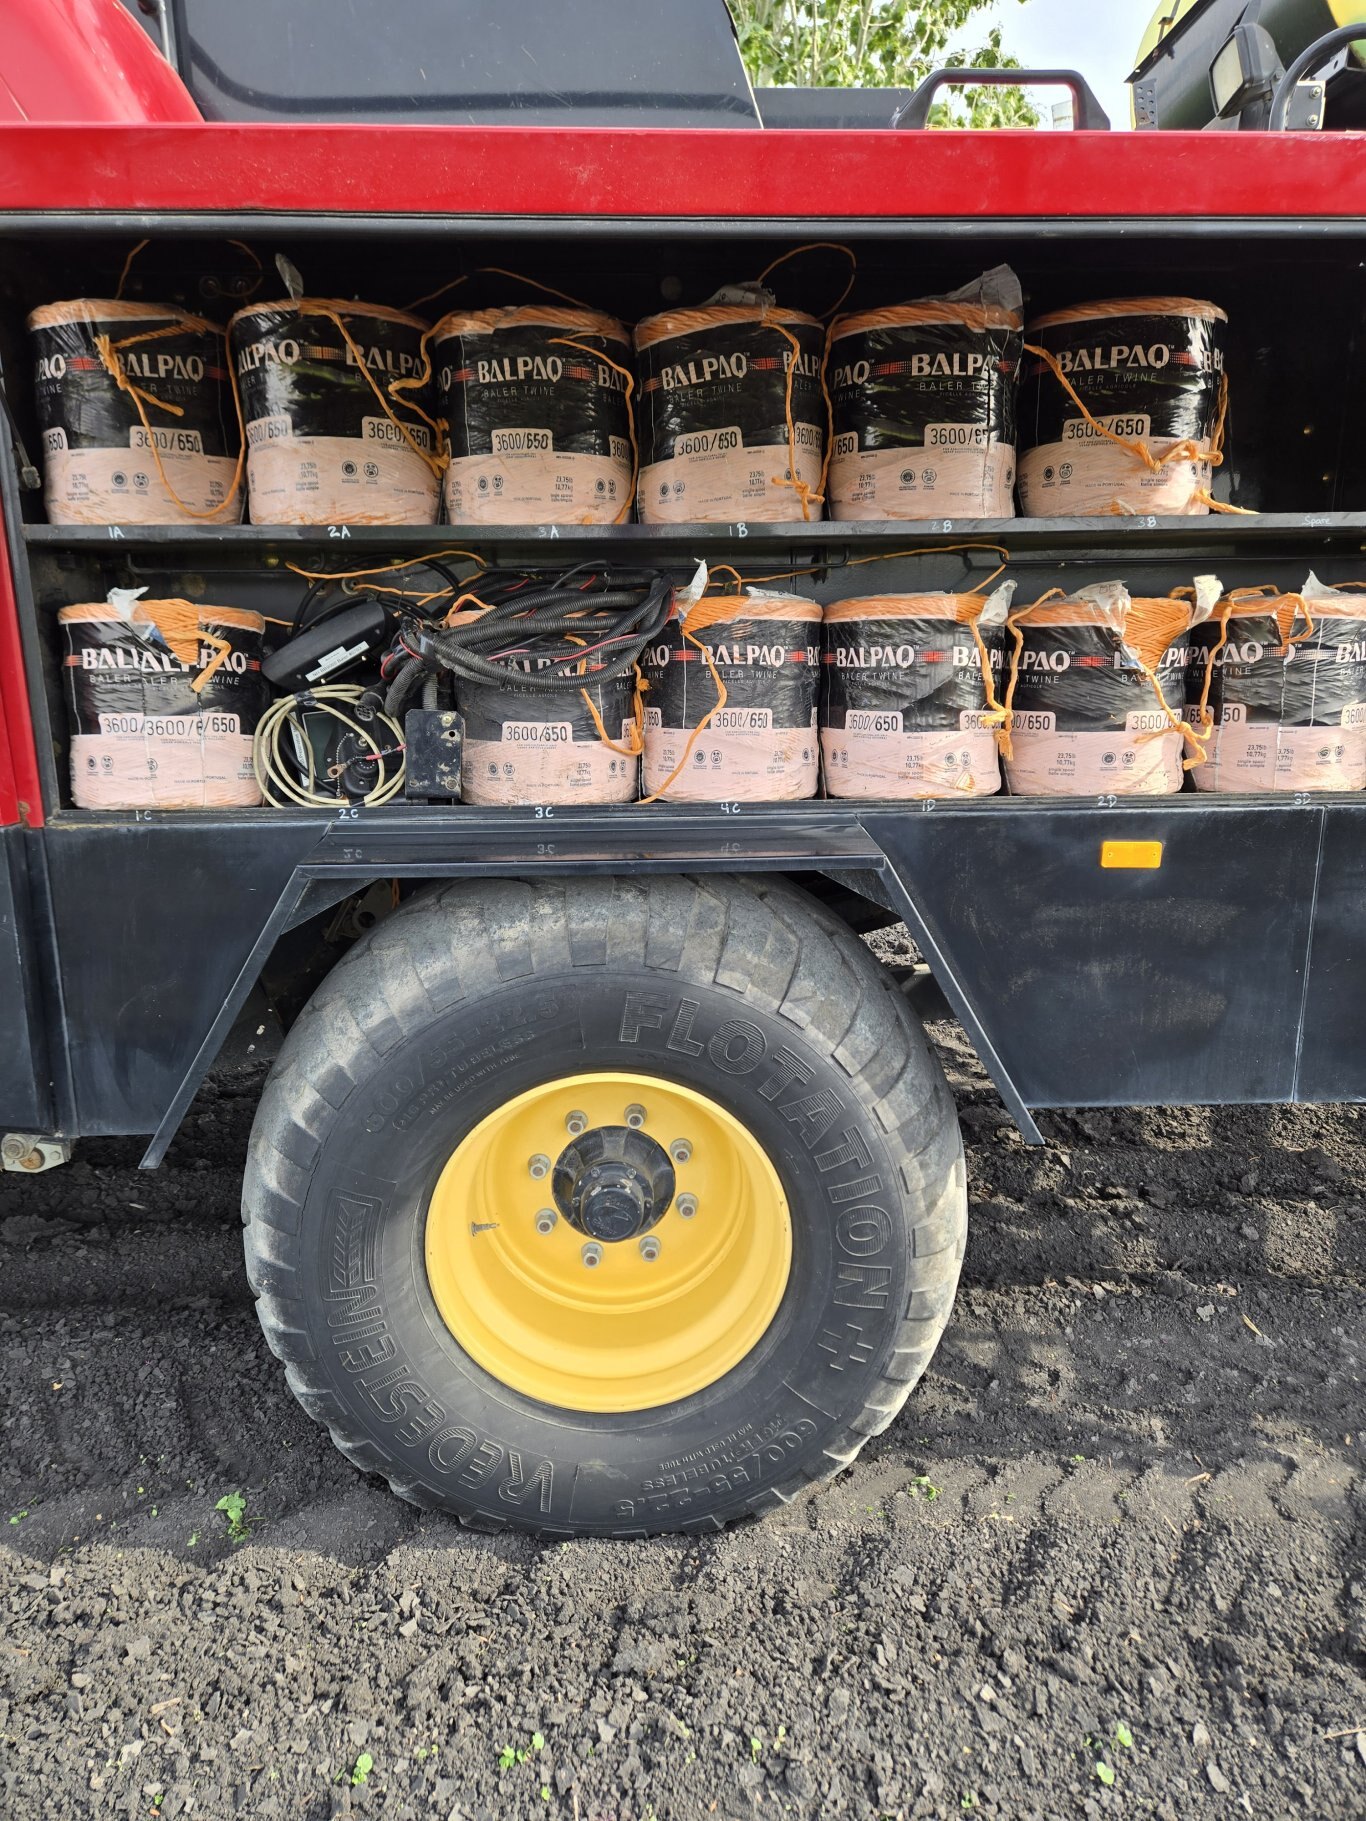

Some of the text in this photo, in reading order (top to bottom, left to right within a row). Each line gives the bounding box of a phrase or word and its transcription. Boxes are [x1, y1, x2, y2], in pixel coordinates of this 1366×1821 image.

[1055, 343, 1169, 374] BALPAQ
[477, 356, 563, 383] BALPAQ
[661, 352, 748, 390] BALPAQ
[1114, 372, 1157, 383] TWINE
[523, 385, 555, 397] TWINE
[712, 382, 742, 395] TWINE
[919, 381, 963, 391] BALER
[495, 432, 549, 451] 3600/650
[677, 430, 738, 456] 3600/650
[1137, 515, 1157, 528] 3B
[1302, 514, 1332, 528] Spare
[108, 526, 125, 539] 1A
[327, 525, 351, 539] 2A
[538, 525, 560, 539] 3A
[729, 522, 749, 538] 1B
[701, 644, 785, 668] BALPAQ
[836, 644, 915, 669] BALPAQ
[705, 670, 777, 679] BLER TWINE
[1025, 675, 1061, 685] TWINE
[715, 711, 768, 729] 3600/650
[506, 725, 568, 741] 3600/650
[922, 799, 936, 812] 1D
[1097, 794, 1118, 808] 2D
[1293, 792, 1312, 806] 3D
[338, 808, 359, 819] 2C
[534, 806, 554, 819] 3C
[720, 803, 741, 814] 4C
[619, 990, 893, 1310] FLOTATION
[324, 1284, 554, 1514] VREDESTEIN
[615, 1418, 819, 1518] 600/55-22.5
